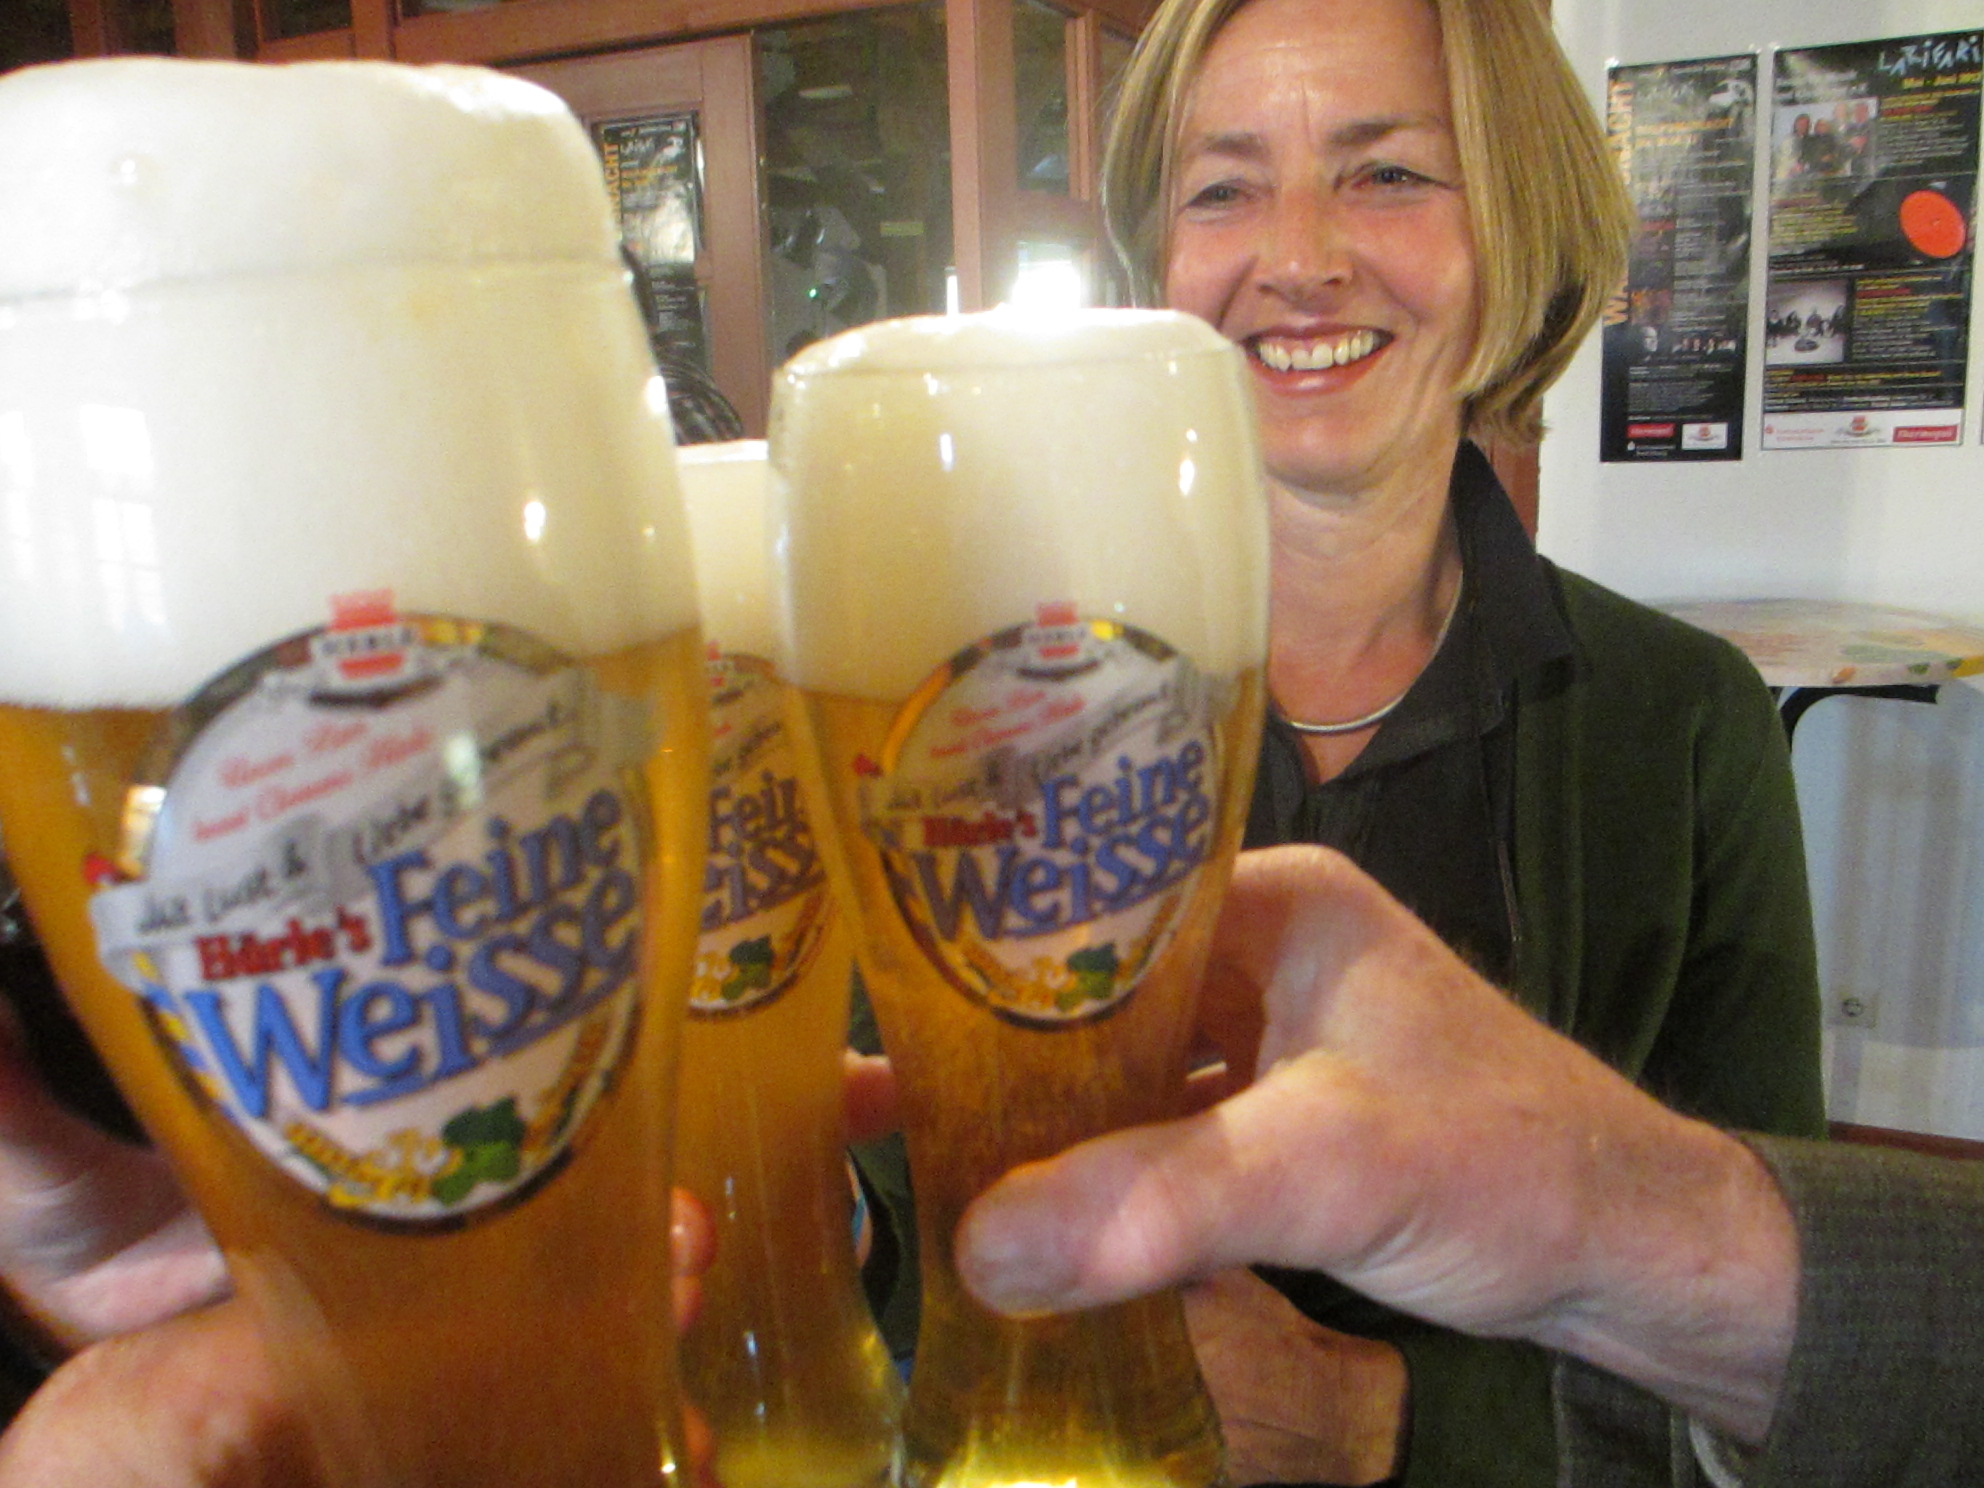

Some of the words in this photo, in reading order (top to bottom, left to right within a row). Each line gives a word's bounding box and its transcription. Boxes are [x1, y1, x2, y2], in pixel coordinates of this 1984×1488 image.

[914, 798, 1211, 941] Weisse
[1040, 740, 1205, 849] Feine
[368, 788, 621, 968] Feine
[180, 868, 638, 1119] Weisse
